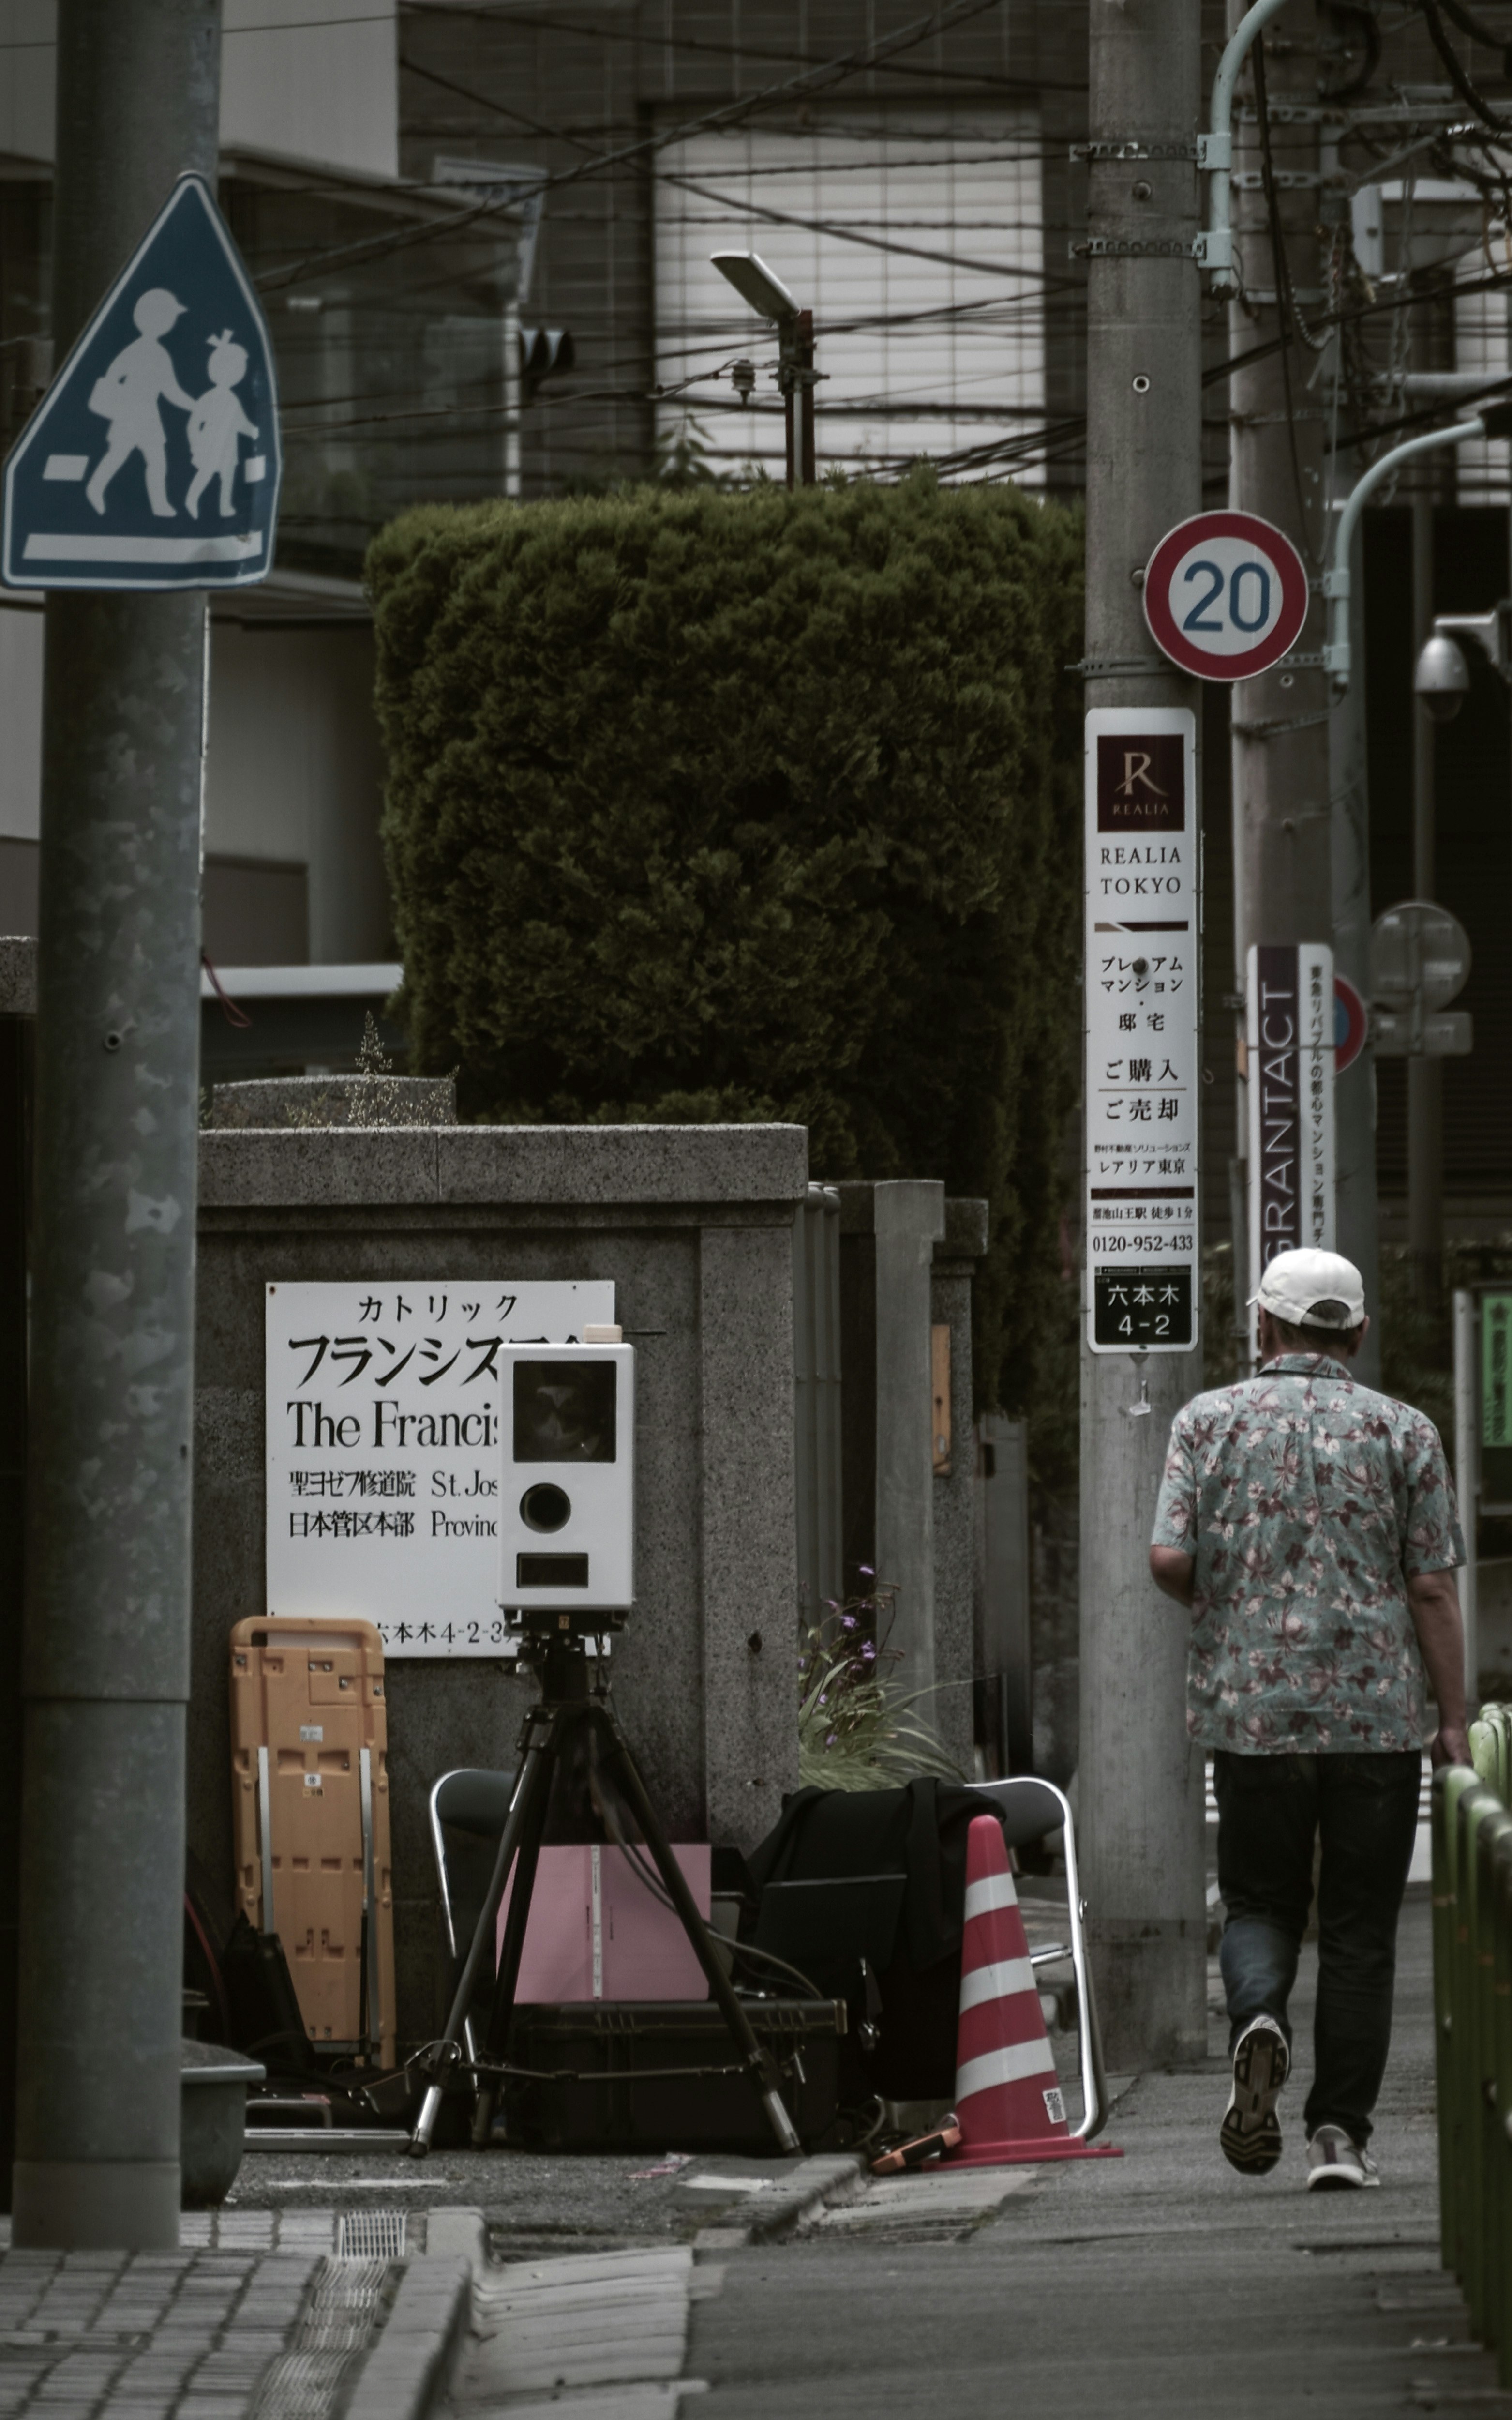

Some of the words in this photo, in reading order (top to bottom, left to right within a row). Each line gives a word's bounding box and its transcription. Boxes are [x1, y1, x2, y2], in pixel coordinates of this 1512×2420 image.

[1183, 560, 1270, 633] 20
[1113, 803, 1169, 815] REALIA
[1101, 847, 1182, 864] REALIA
[1101, 877, 1181, 894] TOKYO
[1101, 956, 1183, 973] プレアム
[1101, 978, 1183, 993] マンション
[1119, 1012, 1165, 1032] 邸宅
[1106, 1058, 1179, 1082] ご購入
[1107, 1098, 1179, 1121] ご売却
[1310, 965, 1325, 1248] 東急リバブルの都心マンション専門チ
[1100, 1157, 1186, 1175] レアリア東京
[1093, 1234, 1193, 1252] 0120-952-433
[1108, 1284, 1180, 1306] 六本木
[359, 1295, 517, 1322] カトリック
[1118, 1314, 1170, 1336] 4-2
[288, 1334, 582, 1389] フランシス
[286, 1401, 361, 1448] The
[373, 1401, 497, 1448] Franci
[289, 1470, 416, 1497] 聖ヨゼフ修道院
[431, 1470, 461, 1497] St.
[289, 1510, 415, 1538] 日本管区本部
